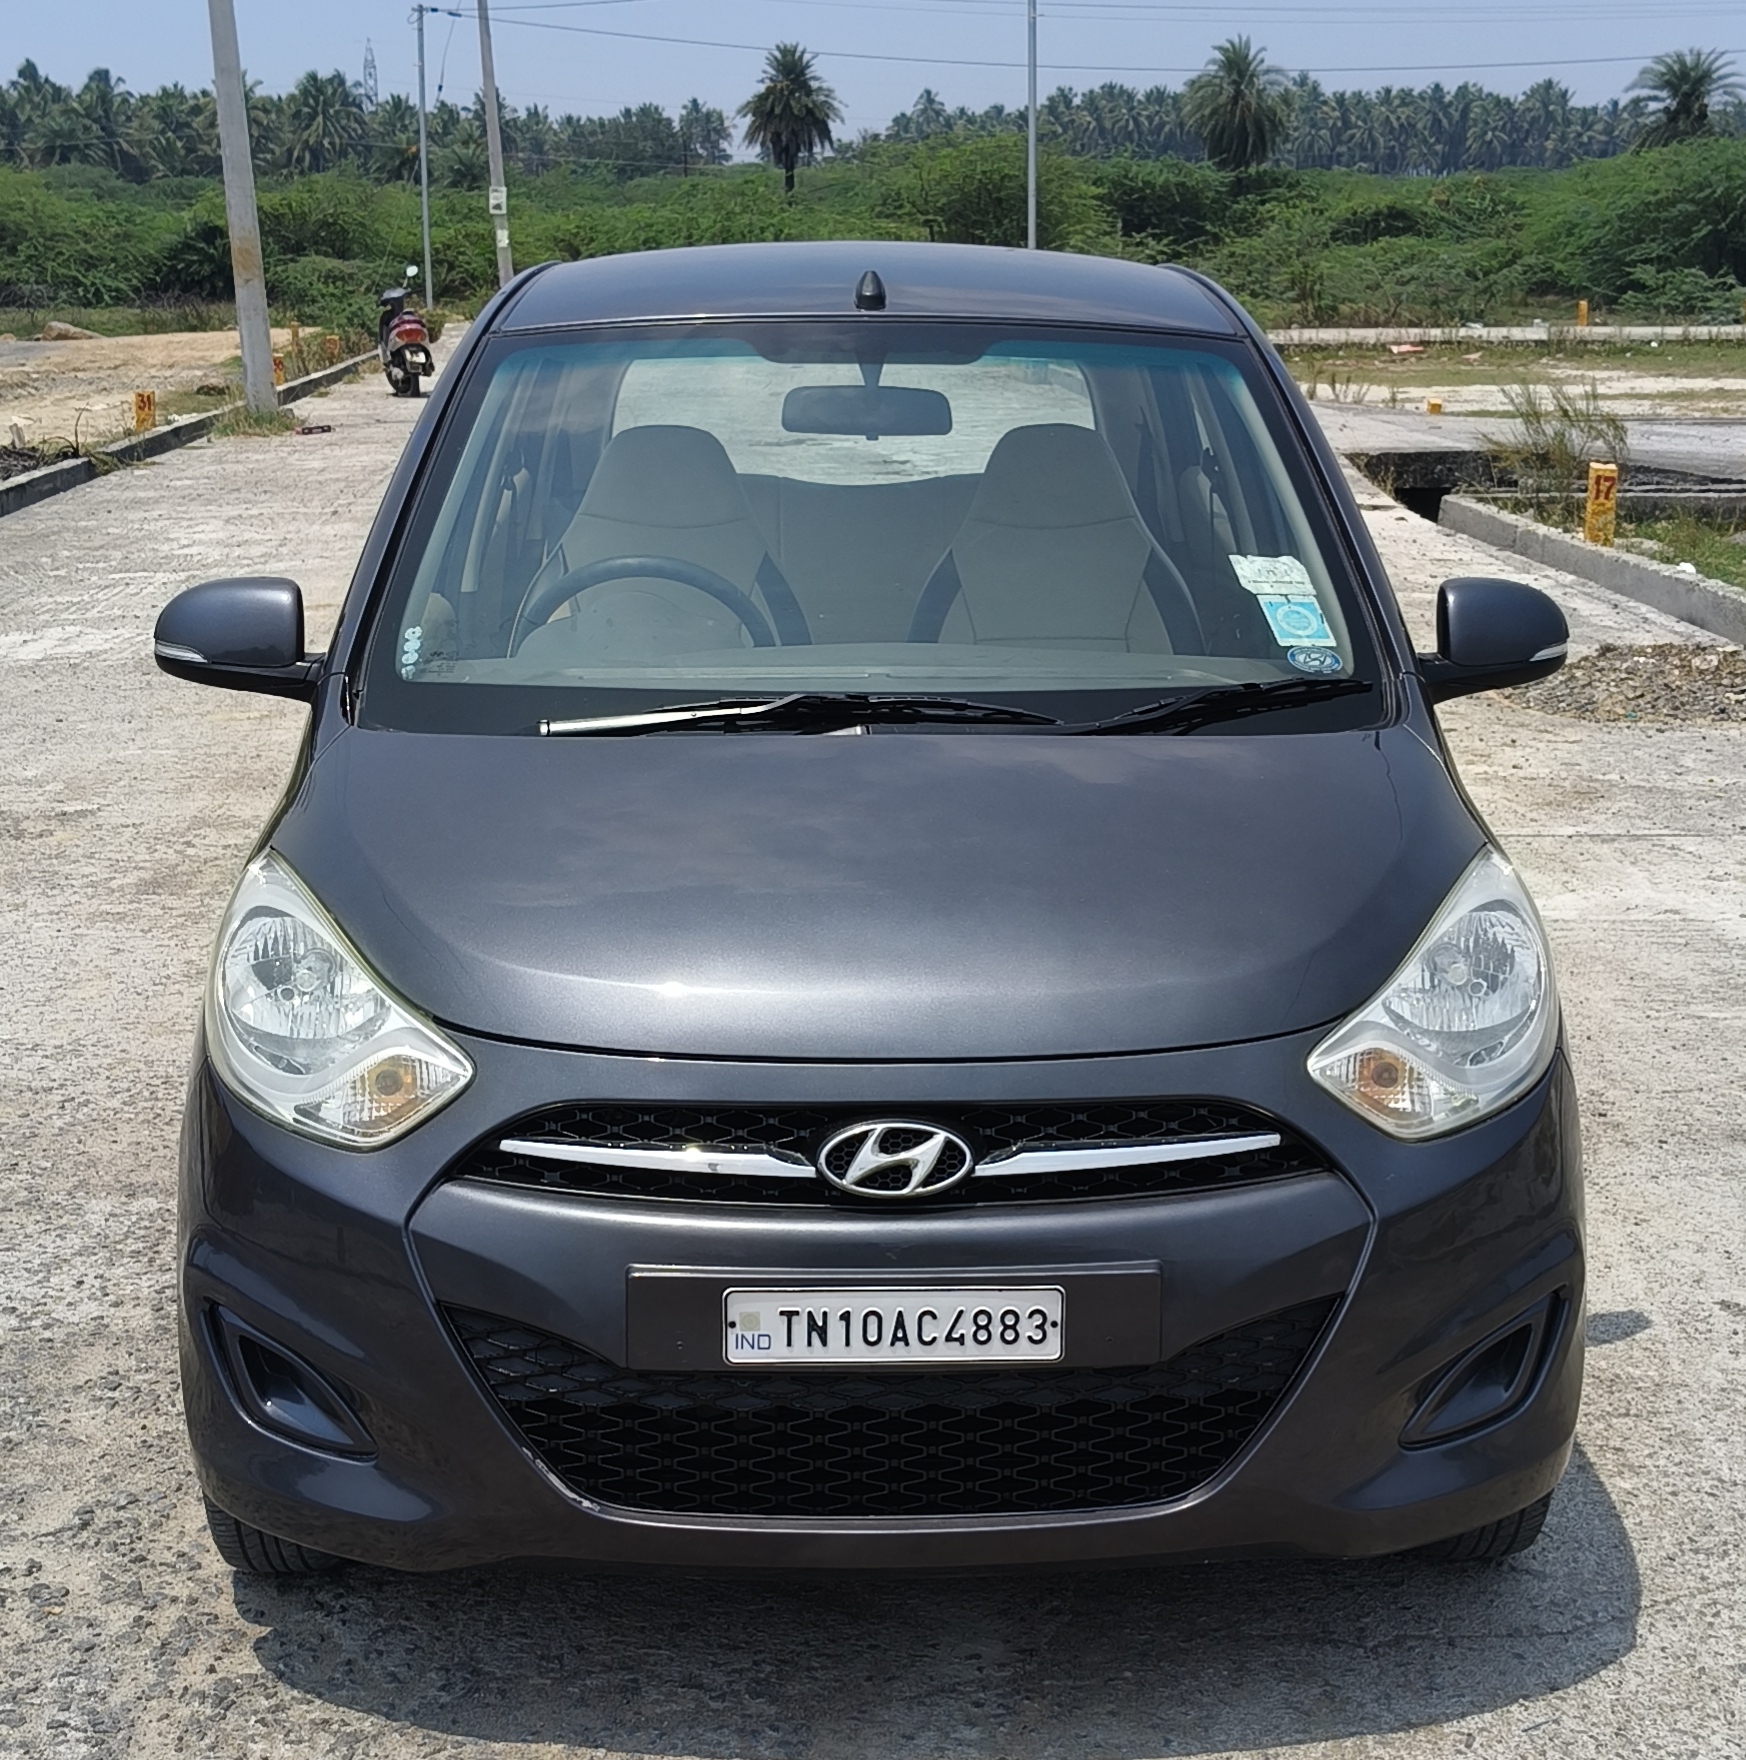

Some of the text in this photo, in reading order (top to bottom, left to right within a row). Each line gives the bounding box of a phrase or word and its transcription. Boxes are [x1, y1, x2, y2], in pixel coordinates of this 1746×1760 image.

[137, 393, 152, 411] 31
[1594, 474, 1616, 501] 17
[779, 1308, 1048, 1348] TN10AC4883
[735, 1333, 771, 1350] IND
